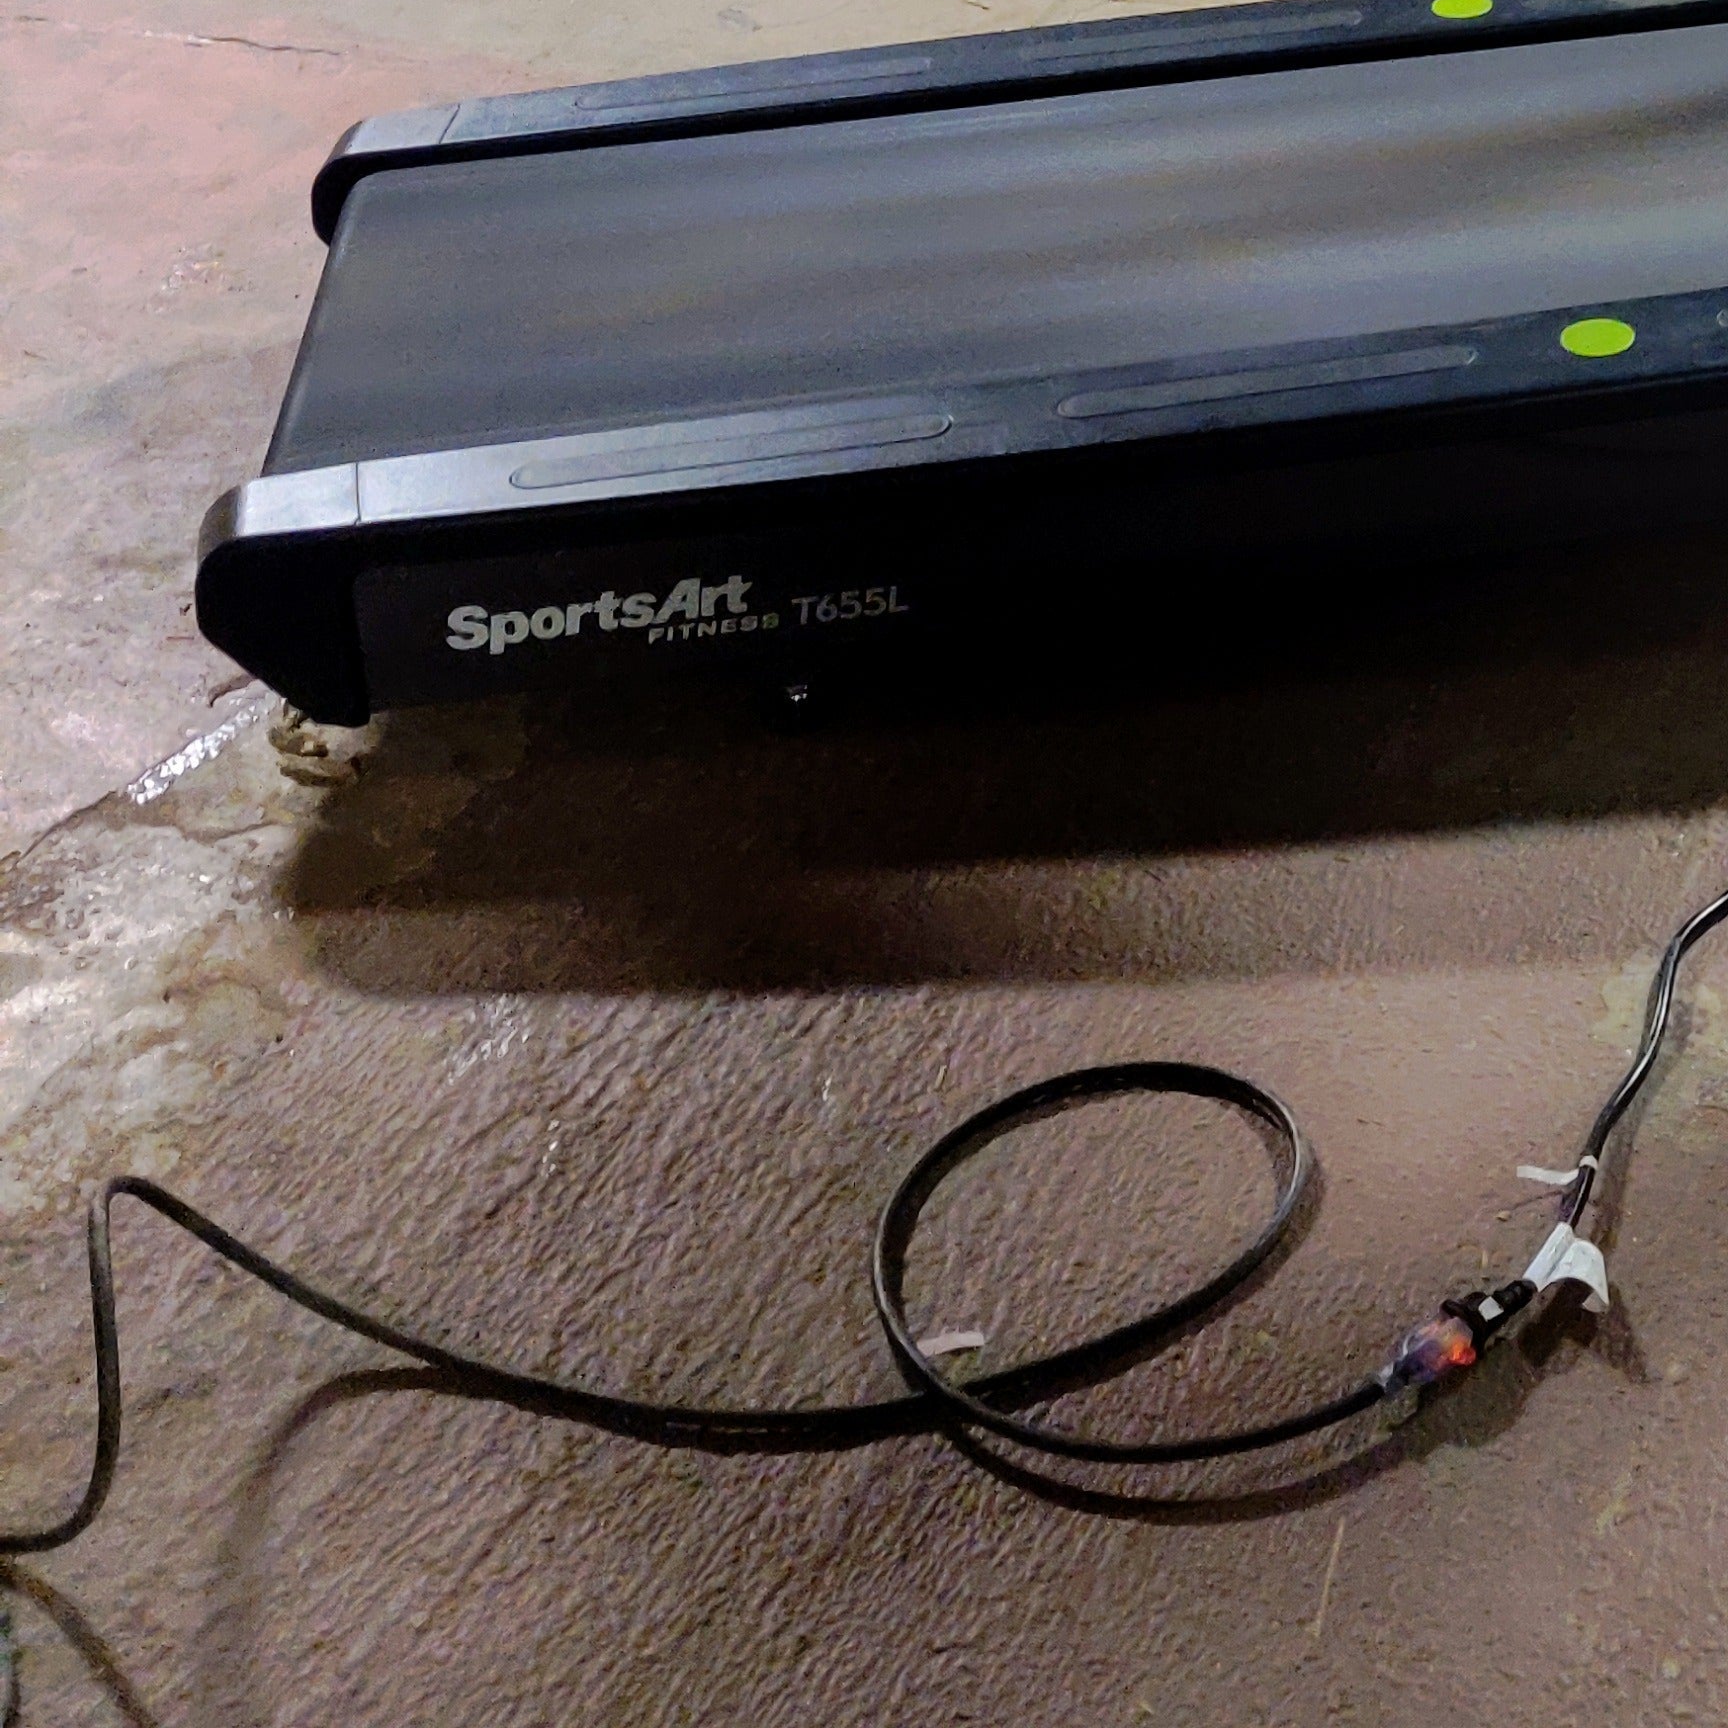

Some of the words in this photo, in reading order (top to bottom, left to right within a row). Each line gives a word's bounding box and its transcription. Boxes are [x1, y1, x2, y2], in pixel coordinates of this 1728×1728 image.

[446, 575, 753, 655] SportsArt
[791, 586, 909, 626] T655L
[648, 612, 780, 645] FITNESS
